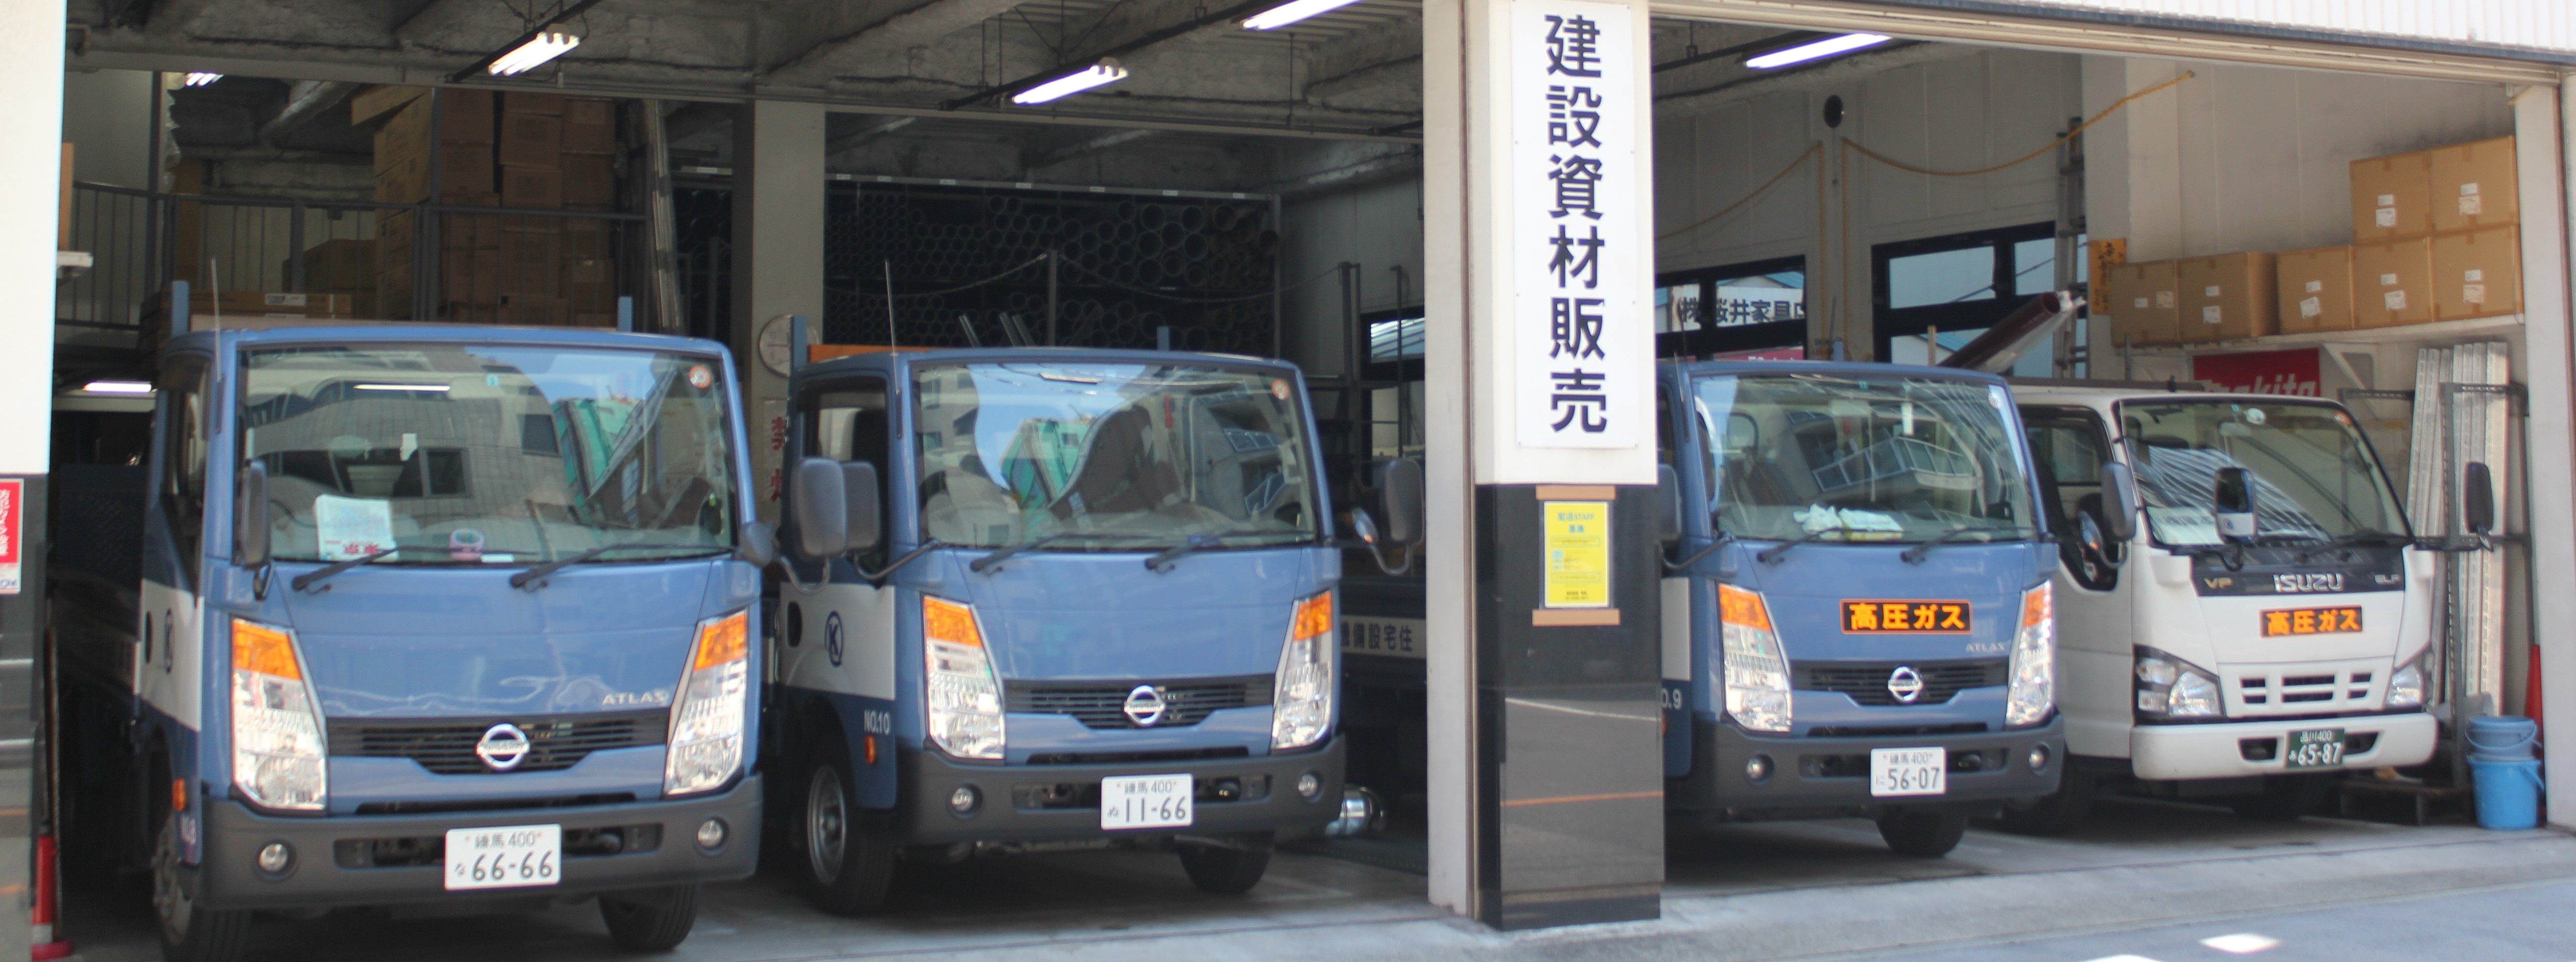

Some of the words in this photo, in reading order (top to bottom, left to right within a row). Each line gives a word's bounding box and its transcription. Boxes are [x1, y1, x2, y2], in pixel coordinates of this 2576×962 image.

[1544, 14, 1607, 434] 建設資材販売
[2203, 577, 2234, 589] VP
[2273, 573, 2343, 592] ISUZU
[1849, 603, 1965, 630] 高圧ガス
[2266, 609, 2360, 636] 高圧ガス
[1965, 642, 2005, 653] ATLAS
[602, 690, 667, 706] ATLAS
[1661, 688, 1683, 710] O.9
[2297, 742, 2341, 766] 65-87
[1887, 767, 1940, 790] 56-07
[1126, 796, 1186, 822] 11-66
[472, 850, 553, 881] 66-66
